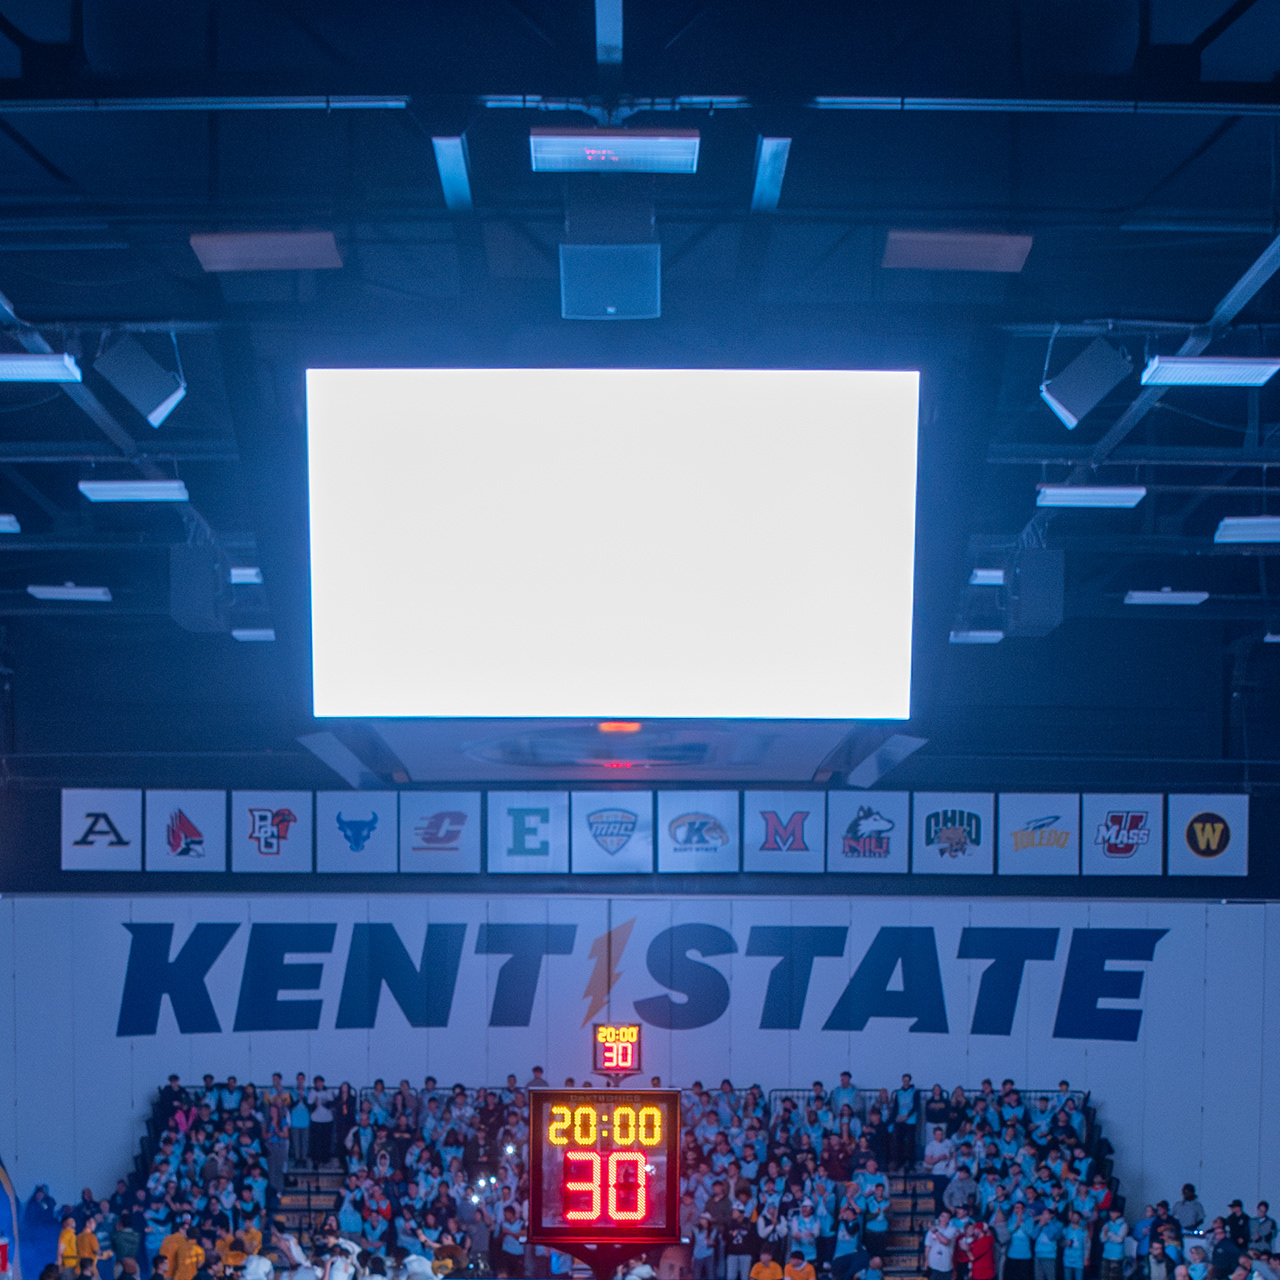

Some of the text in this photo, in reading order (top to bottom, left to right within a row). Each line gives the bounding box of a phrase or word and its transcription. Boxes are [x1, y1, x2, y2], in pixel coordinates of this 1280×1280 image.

[72, 811, 131, 848] A
[506, 807, 550, 857] E
[590, 822, 637, 838] MAC
[759, 810, 812, 853] M
[843, 836, 891, 855] NIU
[924, 808, 982, 849] OHIO
[1010, 829, 1070, 852] TOLEDO
[1192, 821, 1226, 852] W
[115, 921, 1172, 1042] KENT STATE
[597, 1026, 639, 1043] 20:00
[603, 1041, 633, 1068] 30
[548, 1105, 662, 1146] 20:00
[565, 1151, 647, 1221] 30
